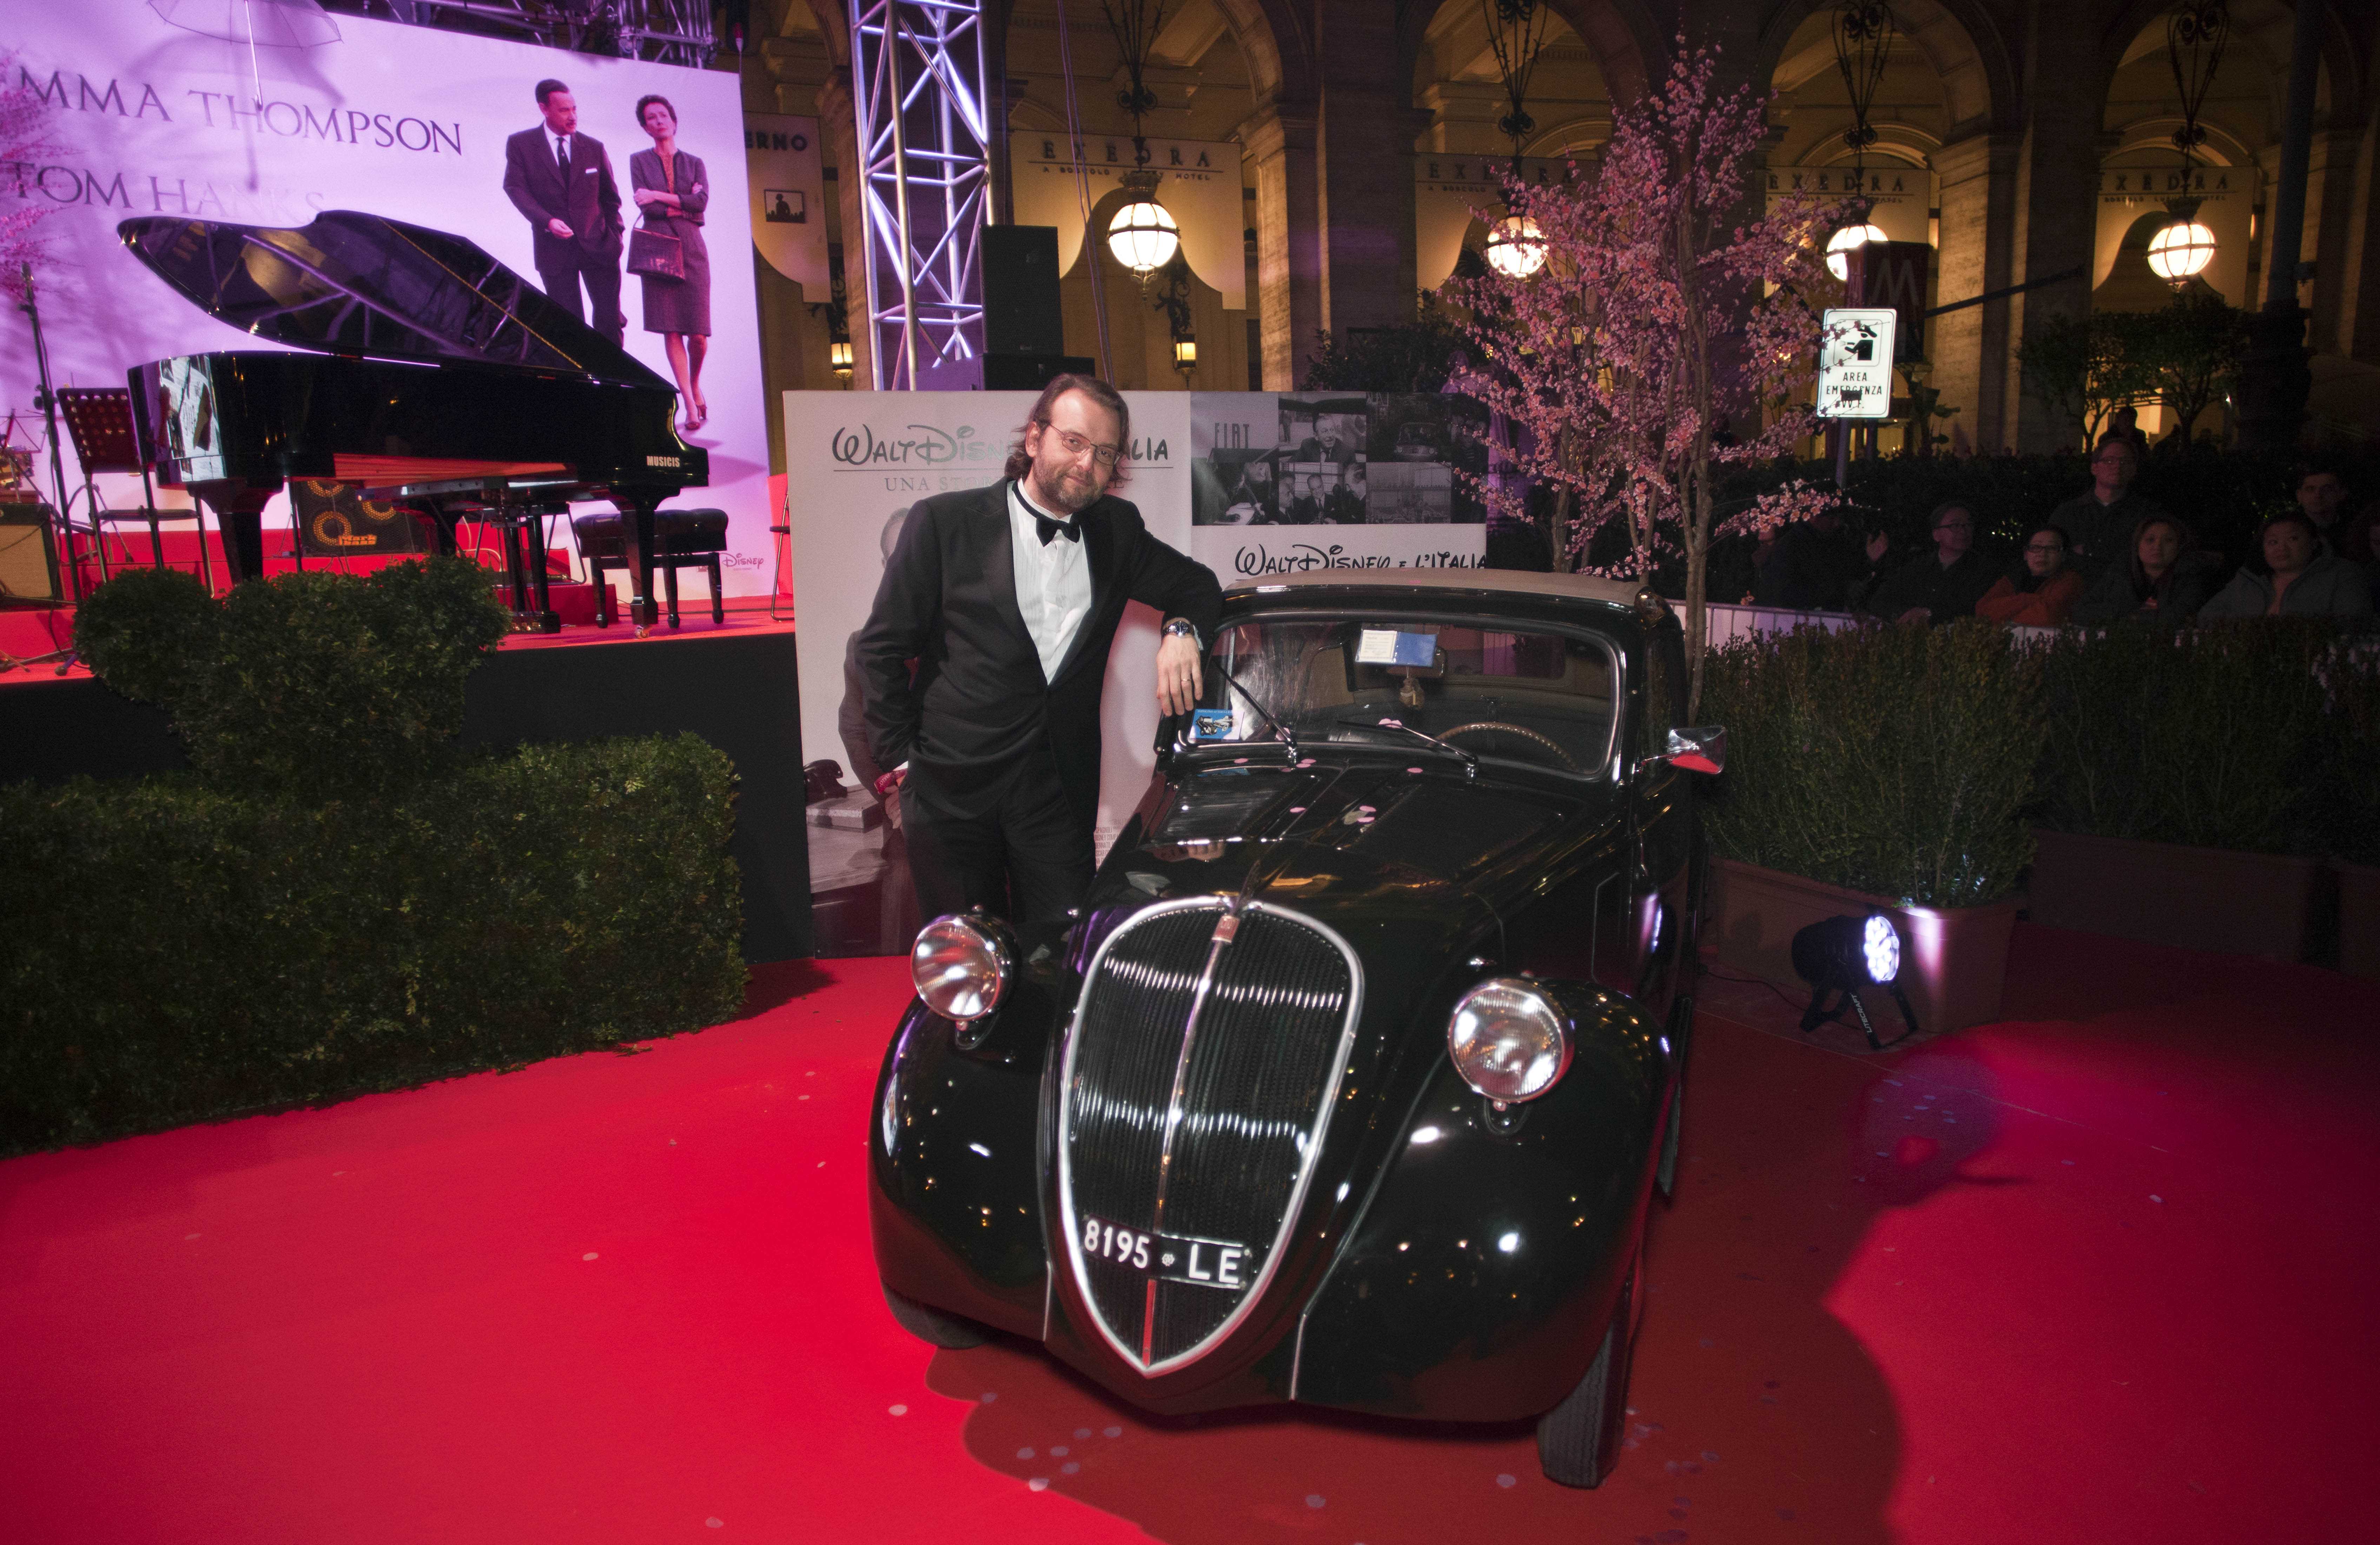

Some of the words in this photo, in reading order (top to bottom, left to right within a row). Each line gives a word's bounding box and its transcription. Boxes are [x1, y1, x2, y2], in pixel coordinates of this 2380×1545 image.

[20, 65, 174, 122] MMA
[187, 89, 462, 156] THOMPSON
[1, 160, 134, 209] TOM
[147, 176, 325, 223] HANKS
[1843, 372, 1867, 381] AREA
[832, 424, 915, 465] WALT
[1215, 423, 1249, 449] FIAT
[647, 456, 680, 467] MUSICIS
[885, 477, 930, 491] UNA
[1235, 544, 1298, 576] WALT
[1851, 994, 1872, 1032] LITECRAFT
[1084, 1219, 1149, 1269] 8195
[1189, 1244, 1241, 1284] LE
